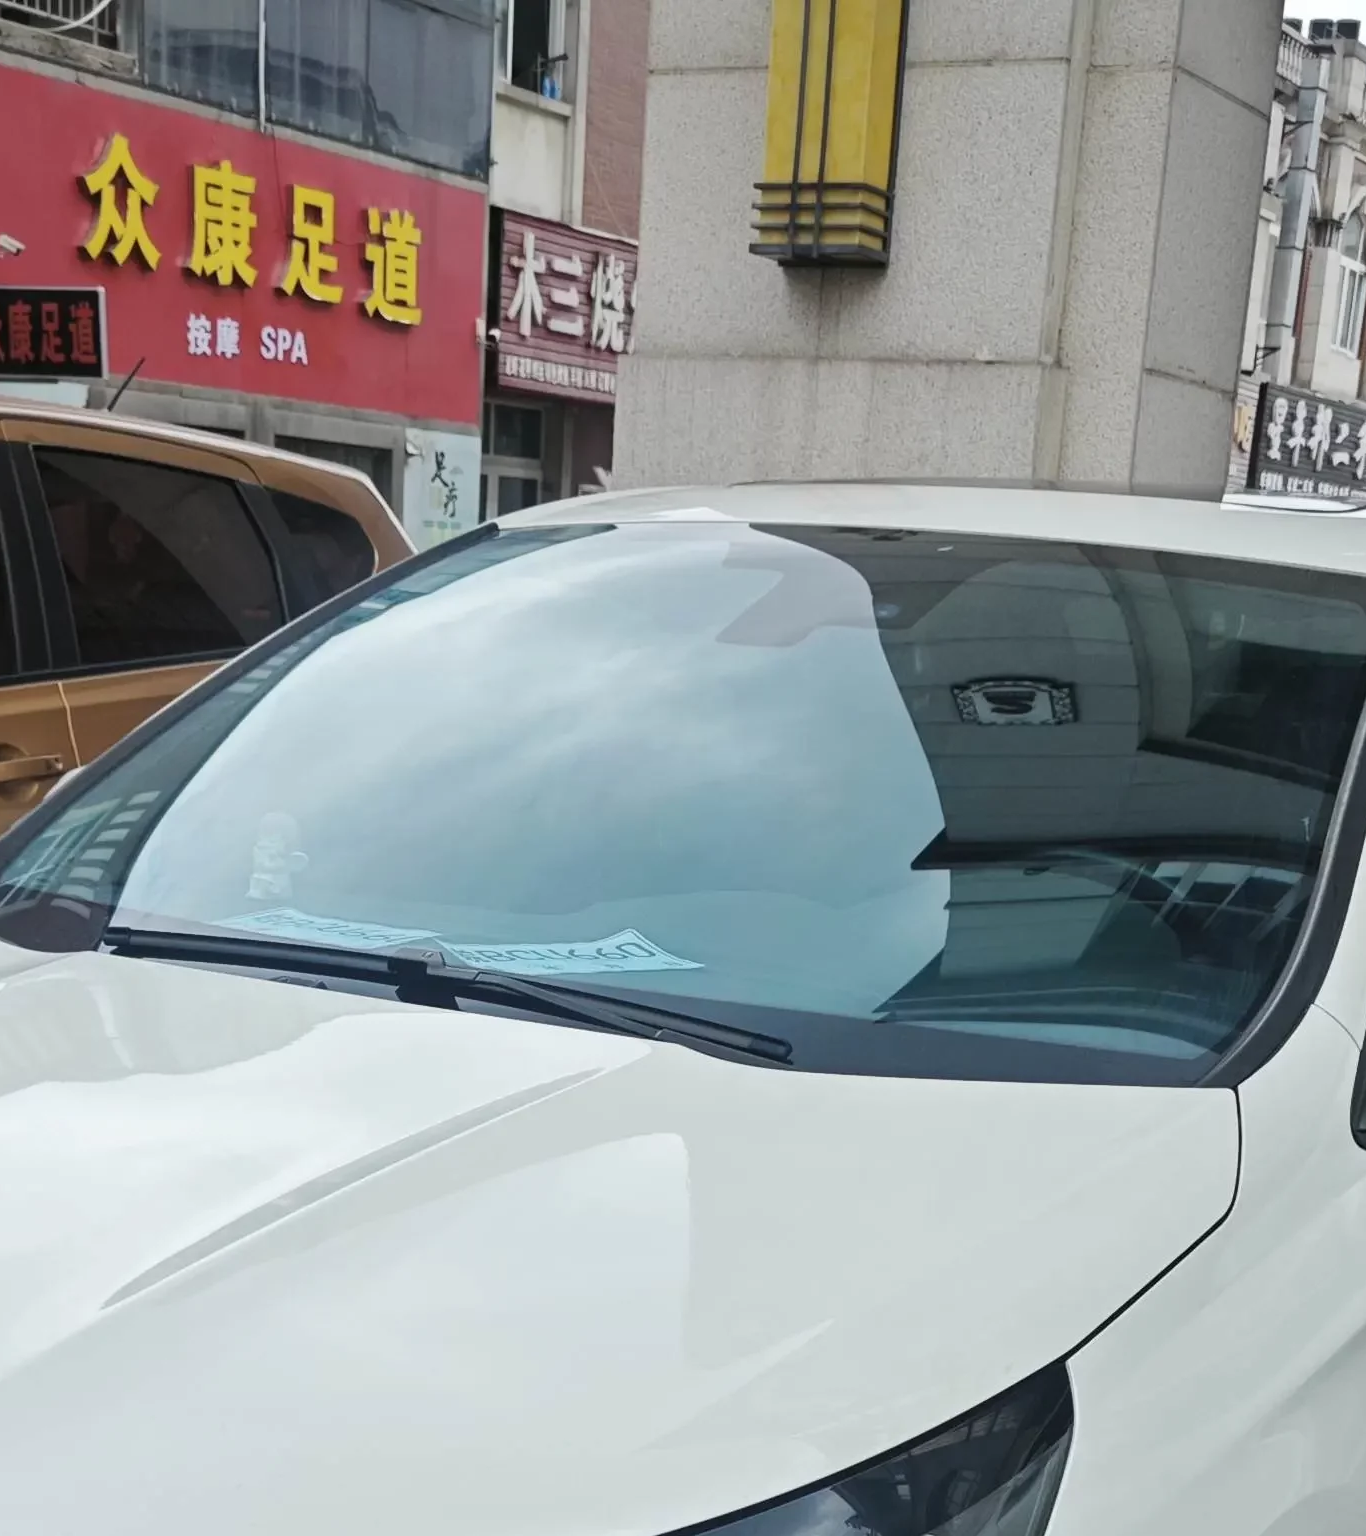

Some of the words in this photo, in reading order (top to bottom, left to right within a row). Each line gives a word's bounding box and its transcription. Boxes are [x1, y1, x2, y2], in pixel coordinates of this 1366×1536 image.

[80, 132, 422, 326] 众康足道
[506, 228, 637, 356] 木三烧
[186, 311, 240, 359] 按摩
[260, 325, 308, 366] SPA
